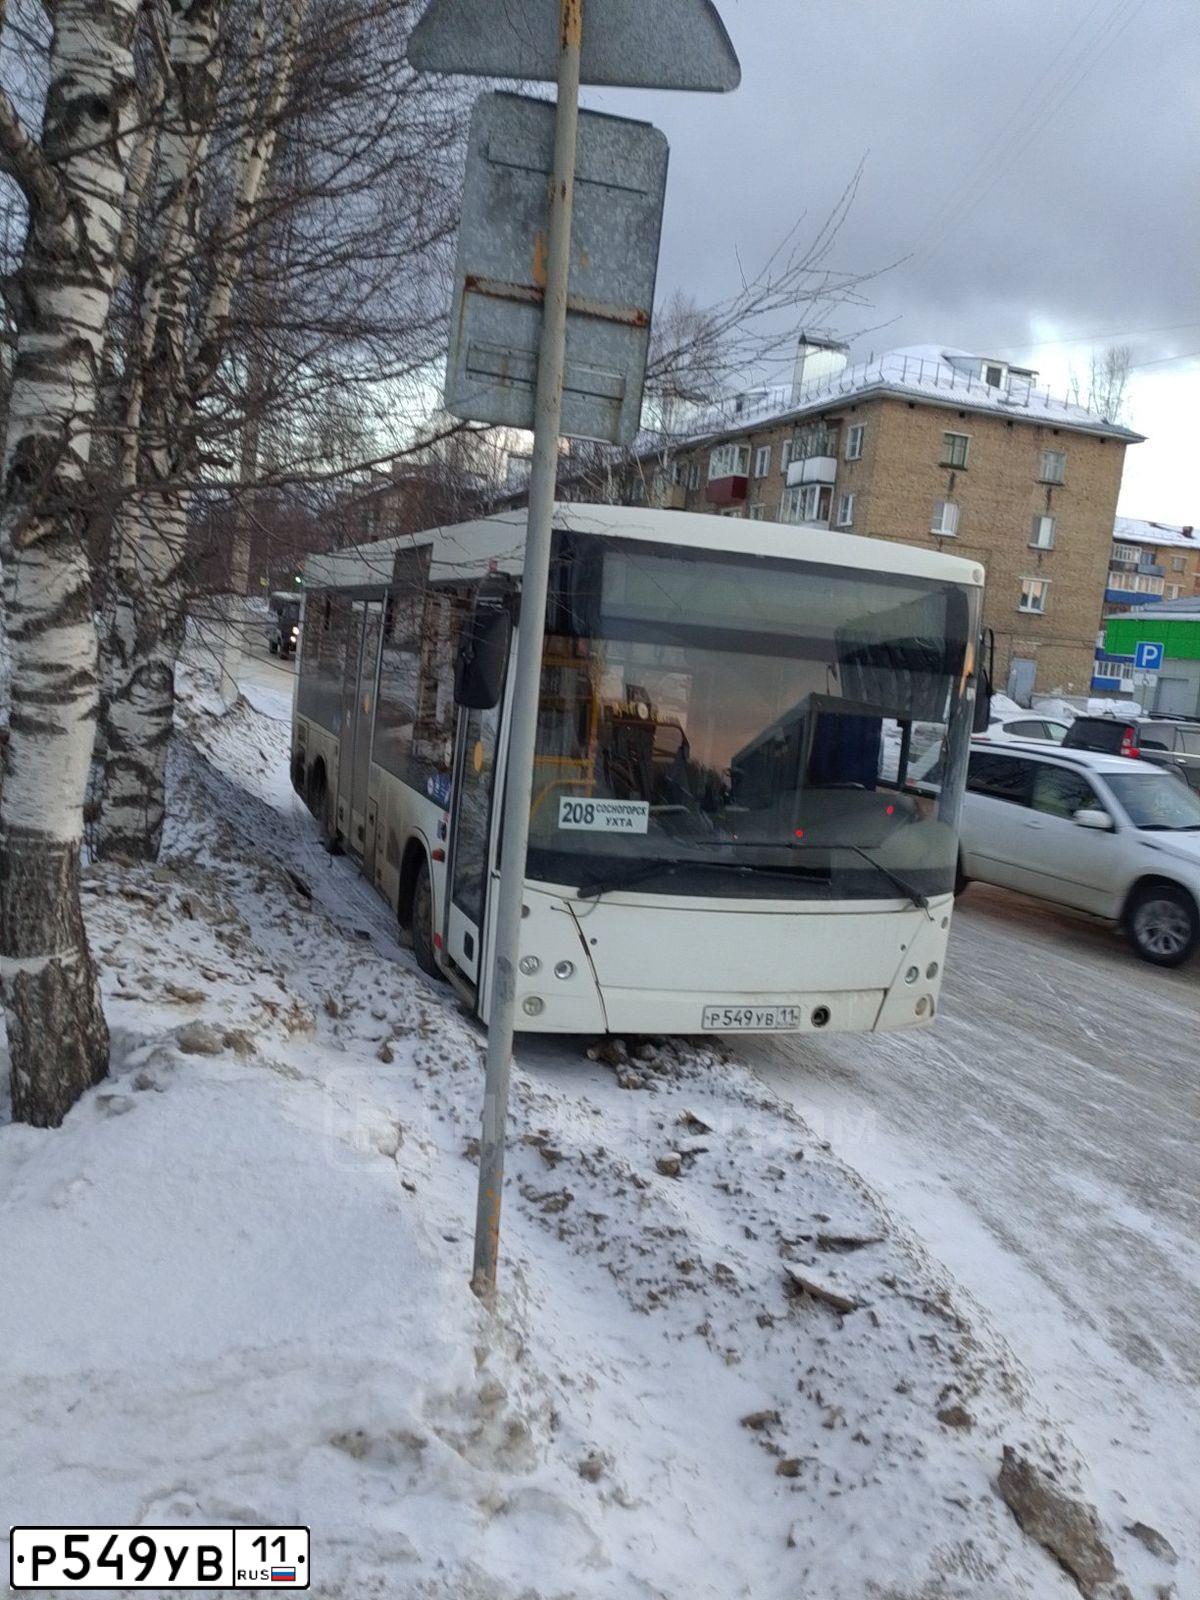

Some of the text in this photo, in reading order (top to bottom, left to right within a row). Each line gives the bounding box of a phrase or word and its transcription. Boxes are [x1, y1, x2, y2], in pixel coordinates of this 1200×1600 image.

[1142, 645, 1158, 666] P
[562, 802, 595, 825] 208
[606, 817, 633, 828] УХТА
[780, 1009, 795, 1021] 11
